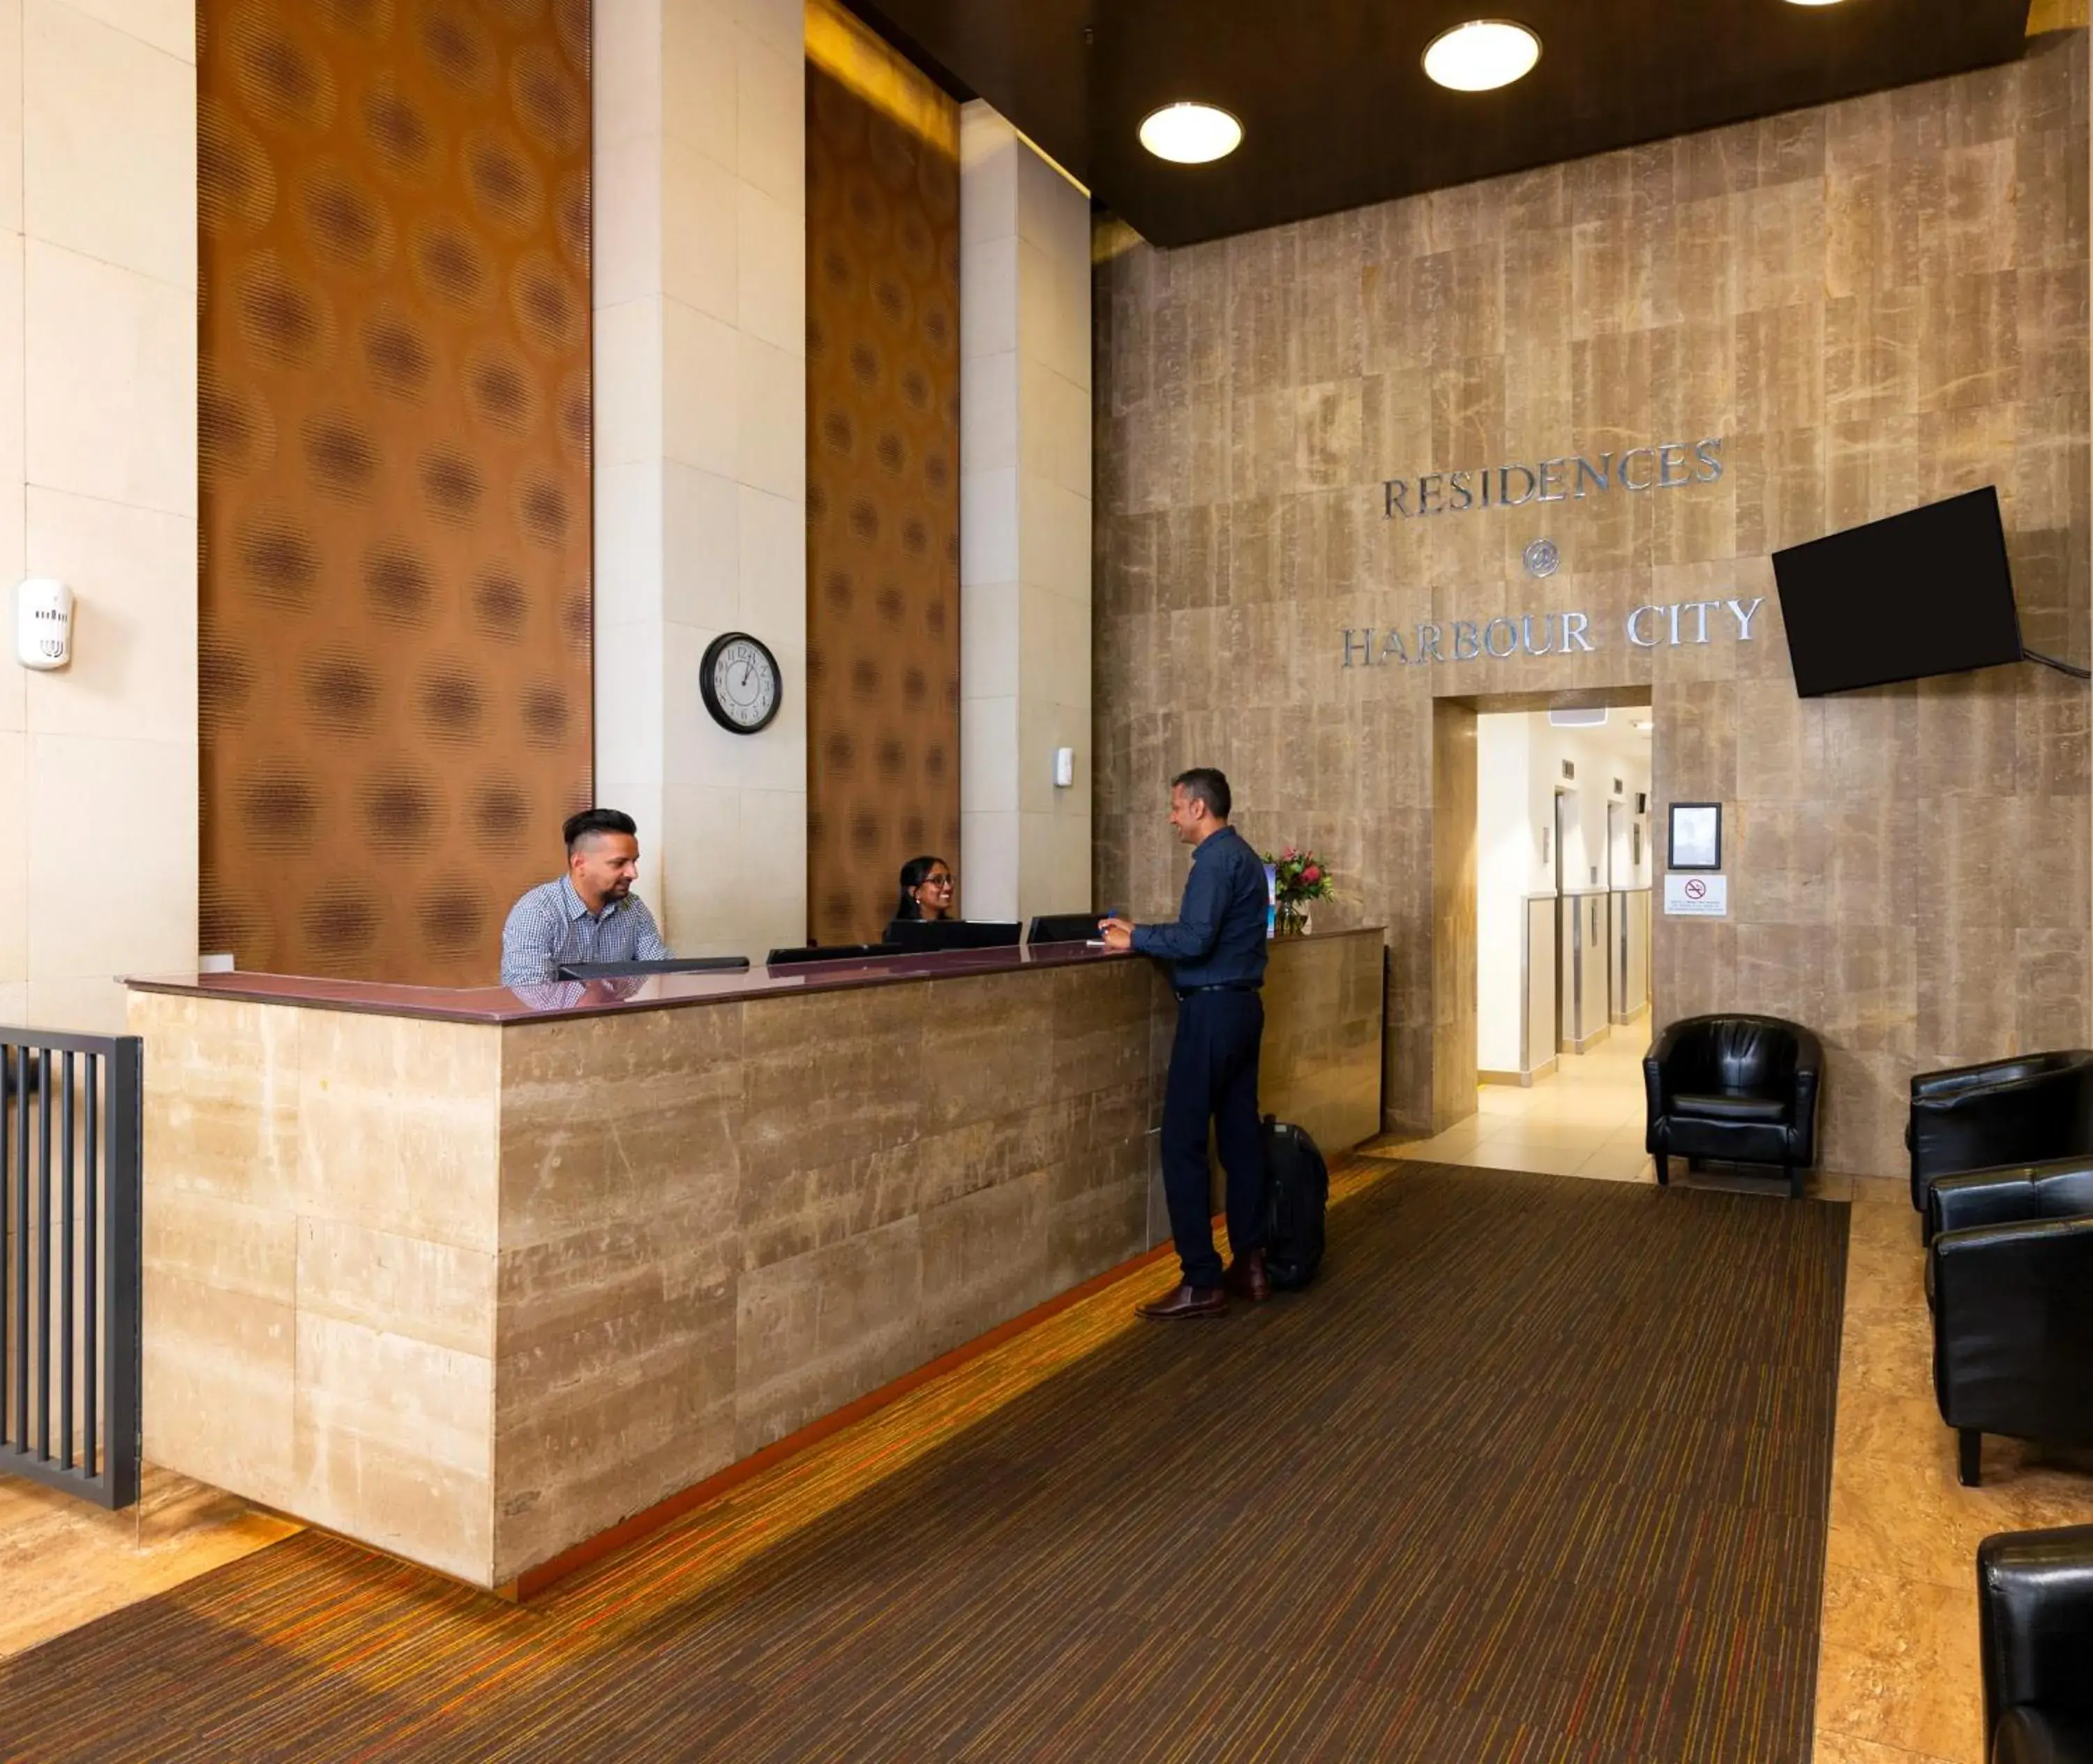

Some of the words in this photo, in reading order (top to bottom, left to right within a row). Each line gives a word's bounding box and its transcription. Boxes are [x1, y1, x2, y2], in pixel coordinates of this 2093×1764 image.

[1382, 438, 1723, 520] RESIDENCES
[737, 646, 747, 659] 12
[1341, 611, 1595, 668] HARBOUR
[1627, 597, 1766, 648] CITY
